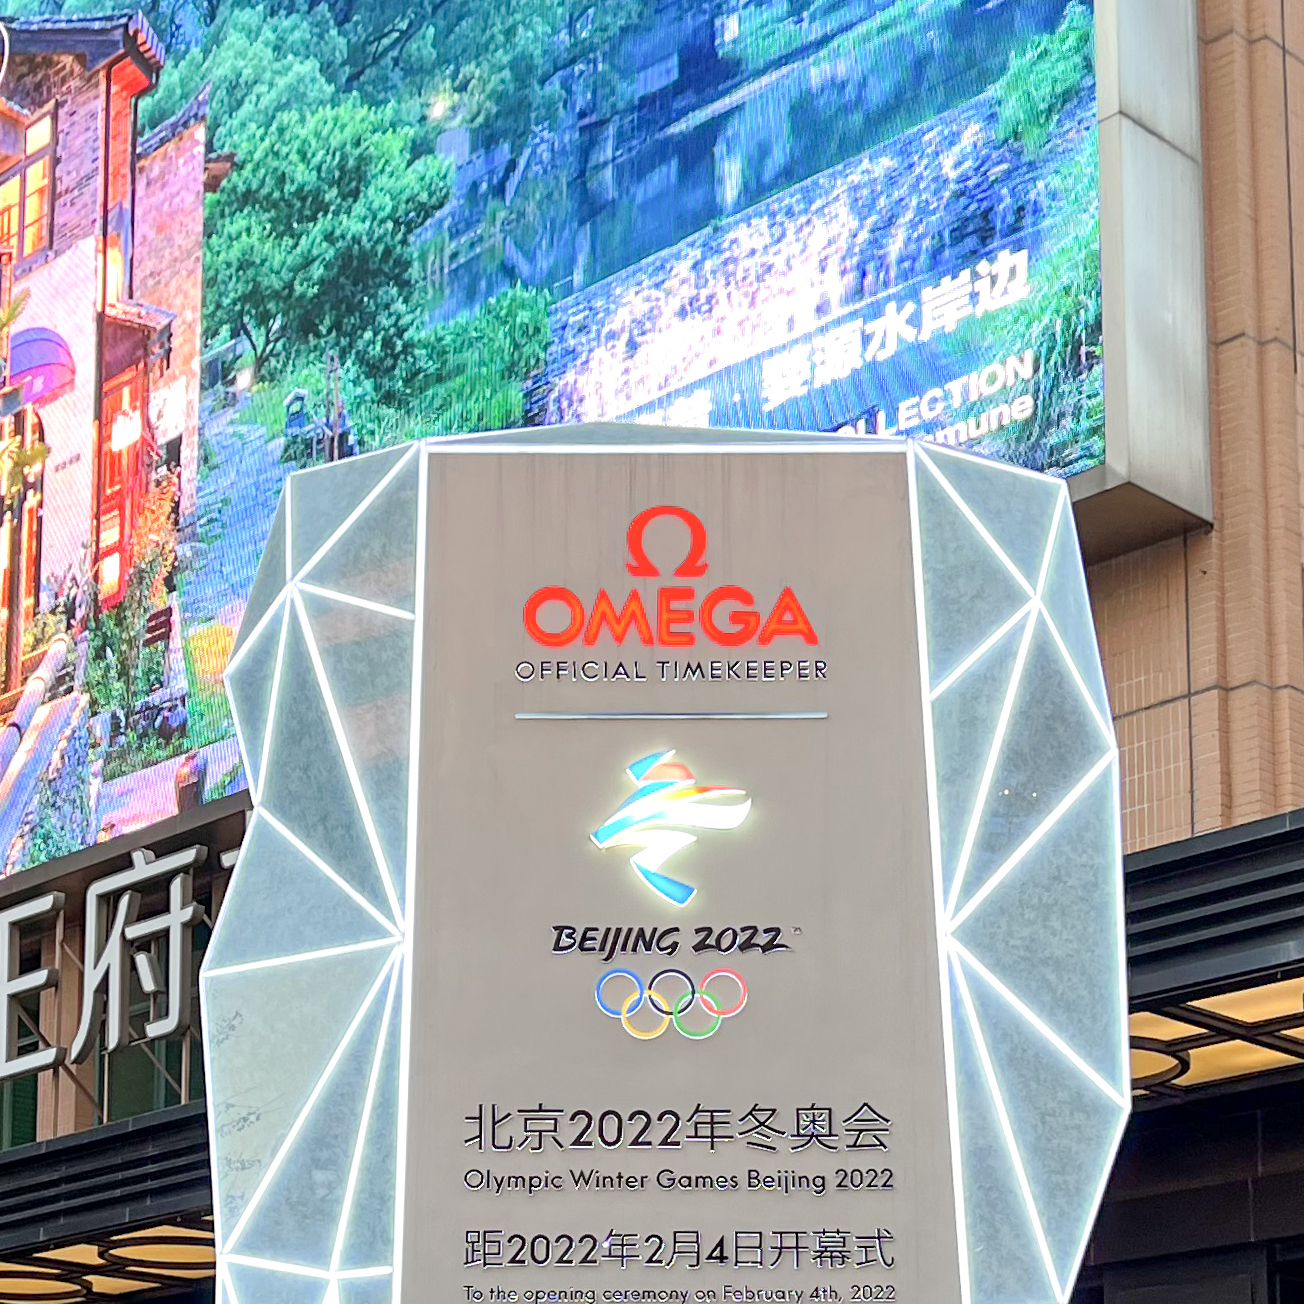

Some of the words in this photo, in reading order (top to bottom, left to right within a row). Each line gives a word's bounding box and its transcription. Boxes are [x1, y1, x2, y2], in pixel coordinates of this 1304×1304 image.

[522, 584, 819, 649] OMEGA
[515, 660, 647, 683] OFFICIAL
[656, 659, 829, 682] TIMEKEEPER
[551, 924, 682, 963] BEIJING
[690, 924, 795, 957] 2022
[464, 1102, 892, 1154] 北京2022年冬奥会
[463, 1168, 563, 1196] Olympic
[569, 1168, 649, 1192] Winter
[656, 1168, 738, 1192] Games
[747, 1168, 827, 1197] Beijing
[834, 1168, 895, 1191] 2022
[463, 1227, 895, 1271] 距2022年2月4日开幕式
[463, 1285, 484, 1303] To
[488, 1285, 519, 1303] the
[694, 1288, 717, 1303] on
[849, 1284, 896, 1303] 2022
